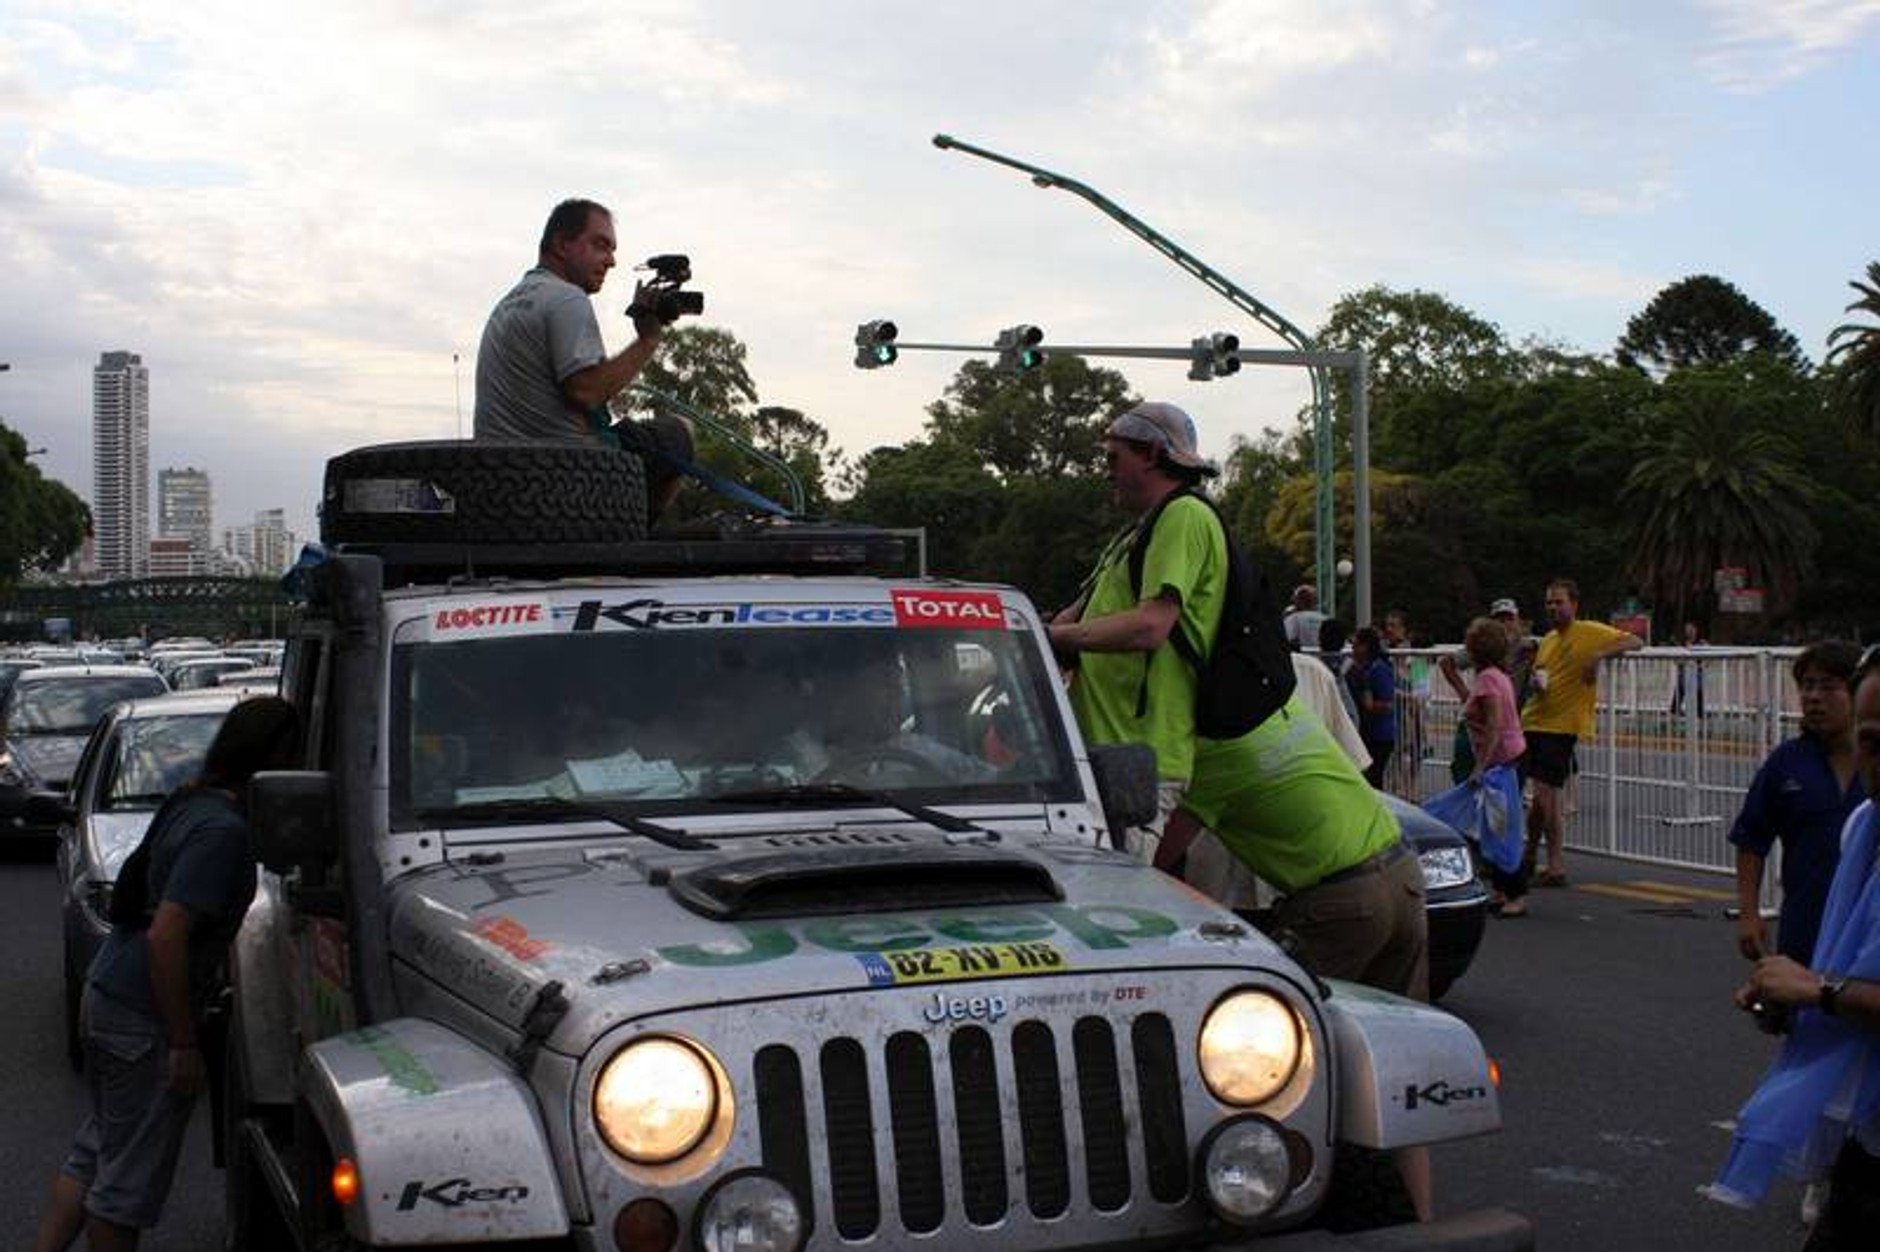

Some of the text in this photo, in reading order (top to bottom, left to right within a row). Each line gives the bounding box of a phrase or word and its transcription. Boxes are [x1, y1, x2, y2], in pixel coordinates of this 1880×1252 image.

[436, 604, 542, 630] LOCTITE
[897, 596, 1001, 619] TOTAL
[923, 992, 1009, 1023] Jeep
[1014, 991, 1085, 1011] powered
[1089, 988, 1110, 1005] by
[1405, 1080, 1486, 1110] Kien
[396, 1178, 529, 1212] Kien
